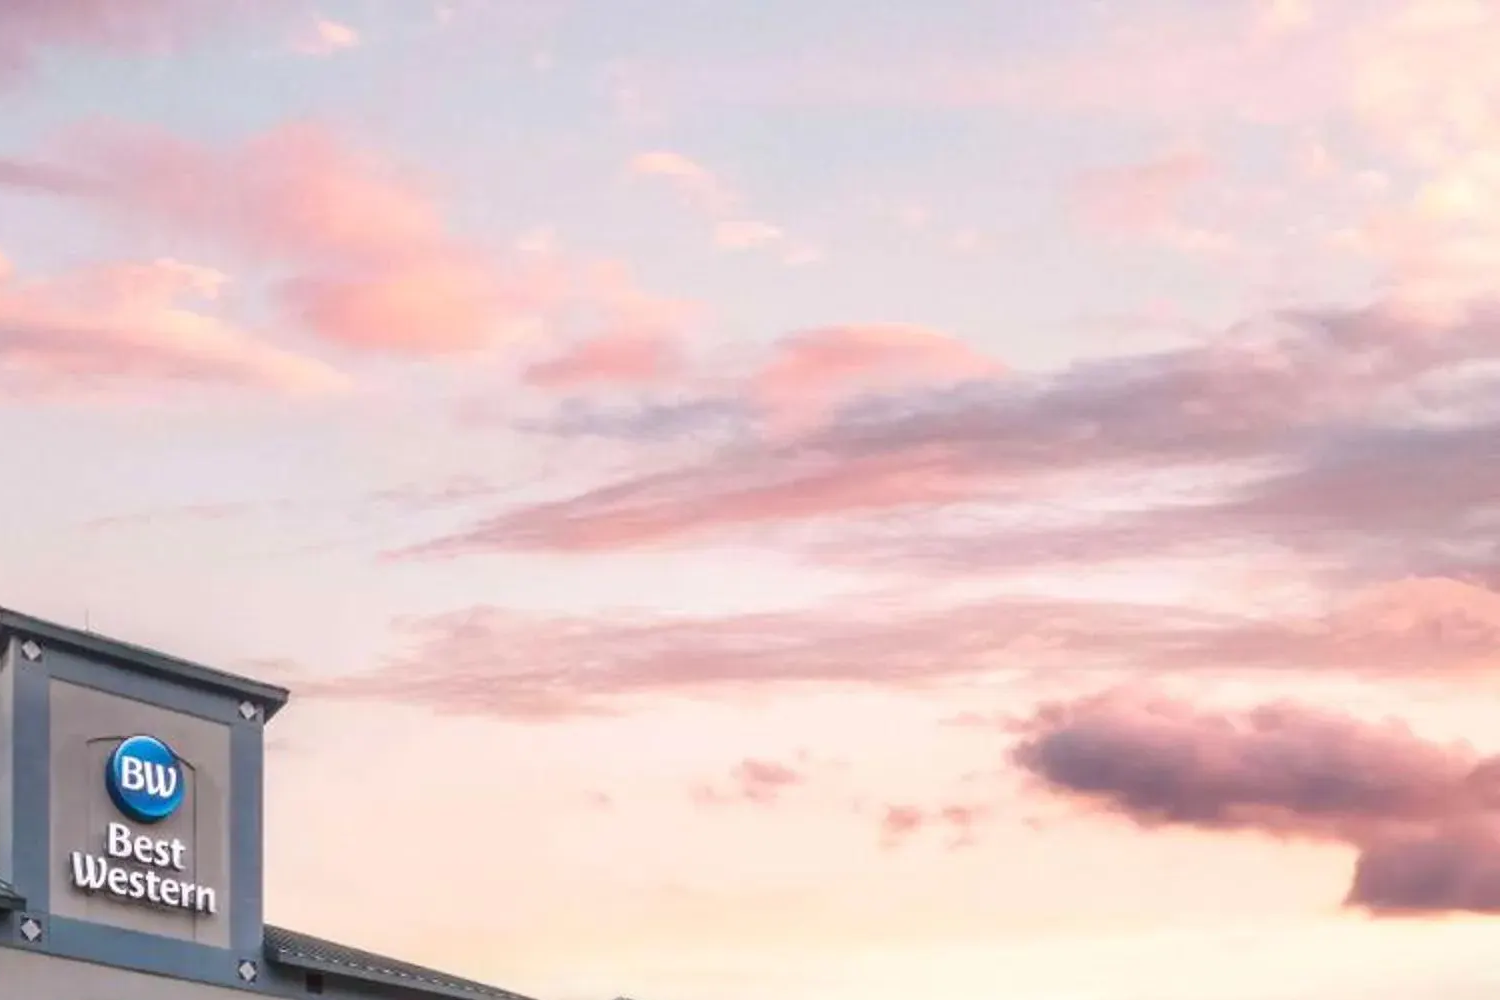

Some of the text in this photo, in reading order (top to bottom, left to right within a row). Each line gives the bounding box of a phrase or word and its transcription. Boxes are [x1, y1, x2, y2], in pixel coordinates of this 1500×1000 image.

[121, 756, 177, 798] BW
[108, 822, 186, 870] Best
[72, 851, 217, 913] Western
